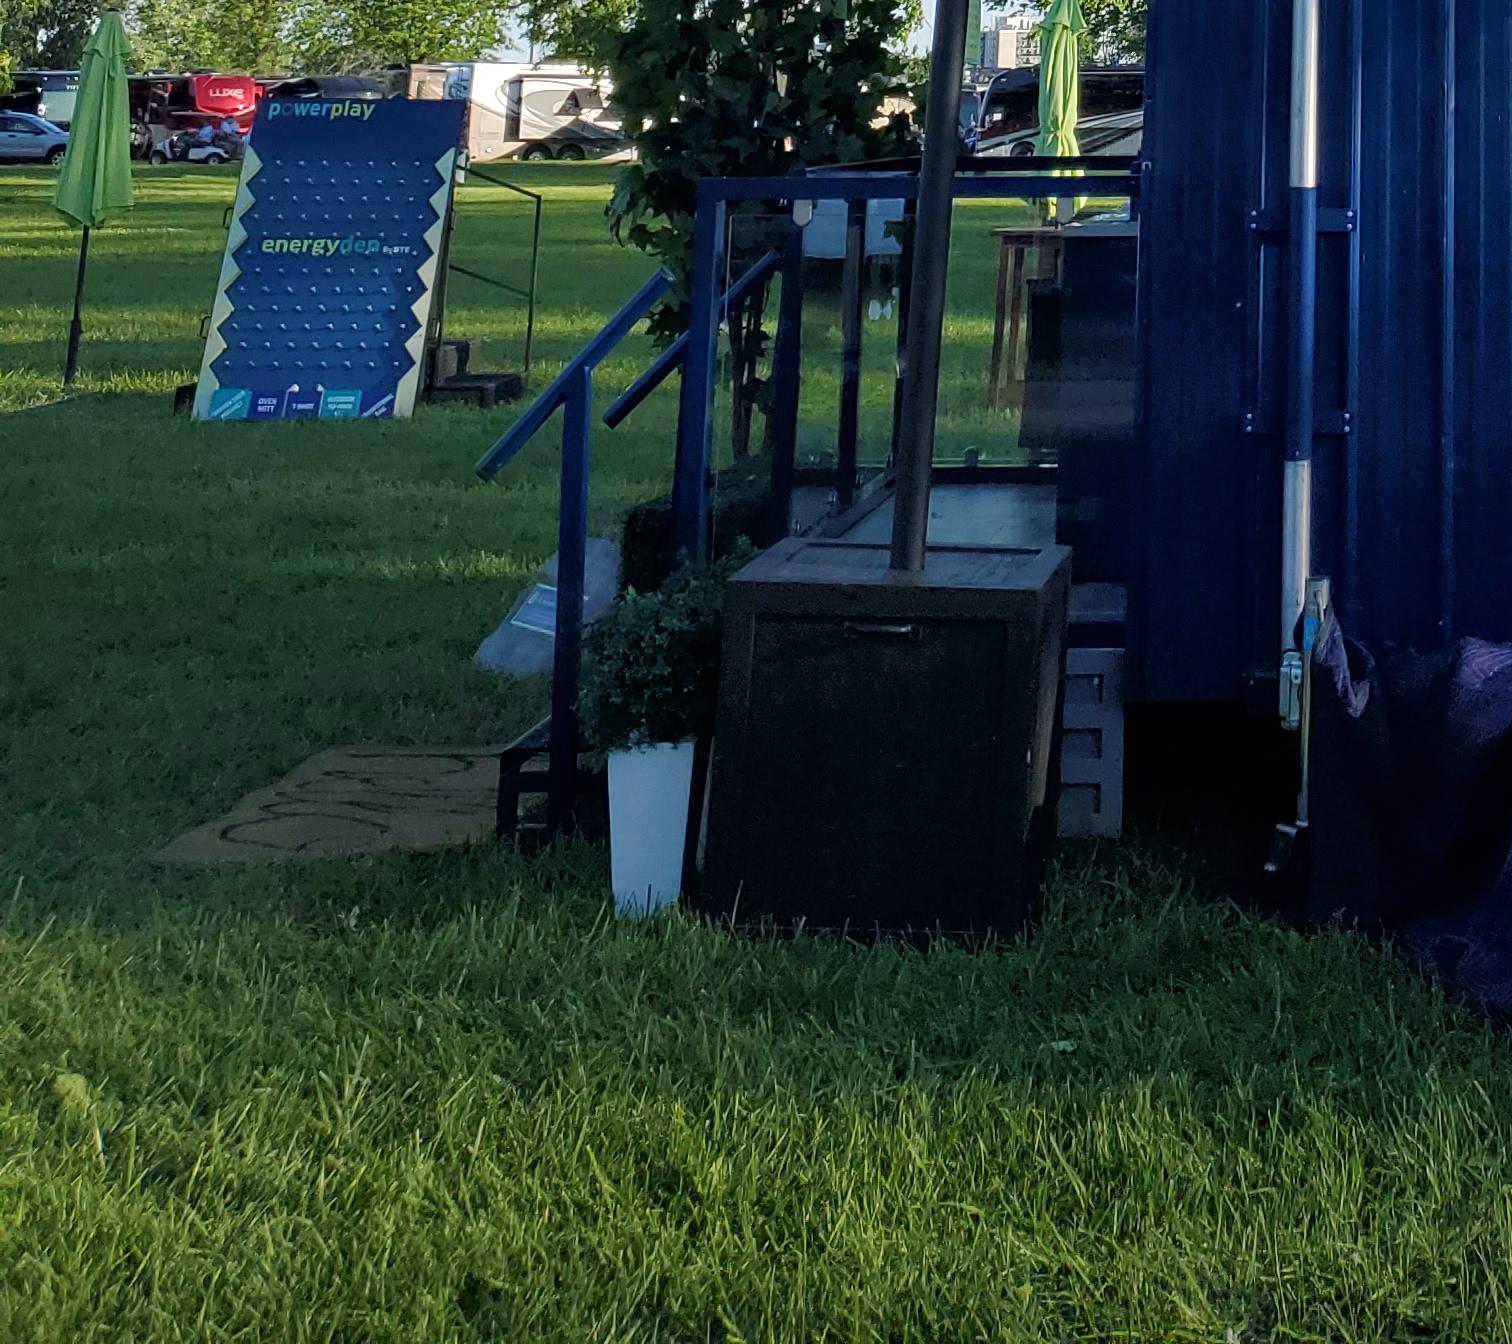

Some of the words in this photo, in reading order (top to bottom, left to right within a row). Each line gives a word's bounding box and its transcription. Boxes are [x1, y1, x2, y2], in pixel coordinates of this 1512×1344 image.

[209, 88, 244, 98] LUXE
[268, 100, 376, 120] powerplay
[261, 235, 380, 257] energyden
